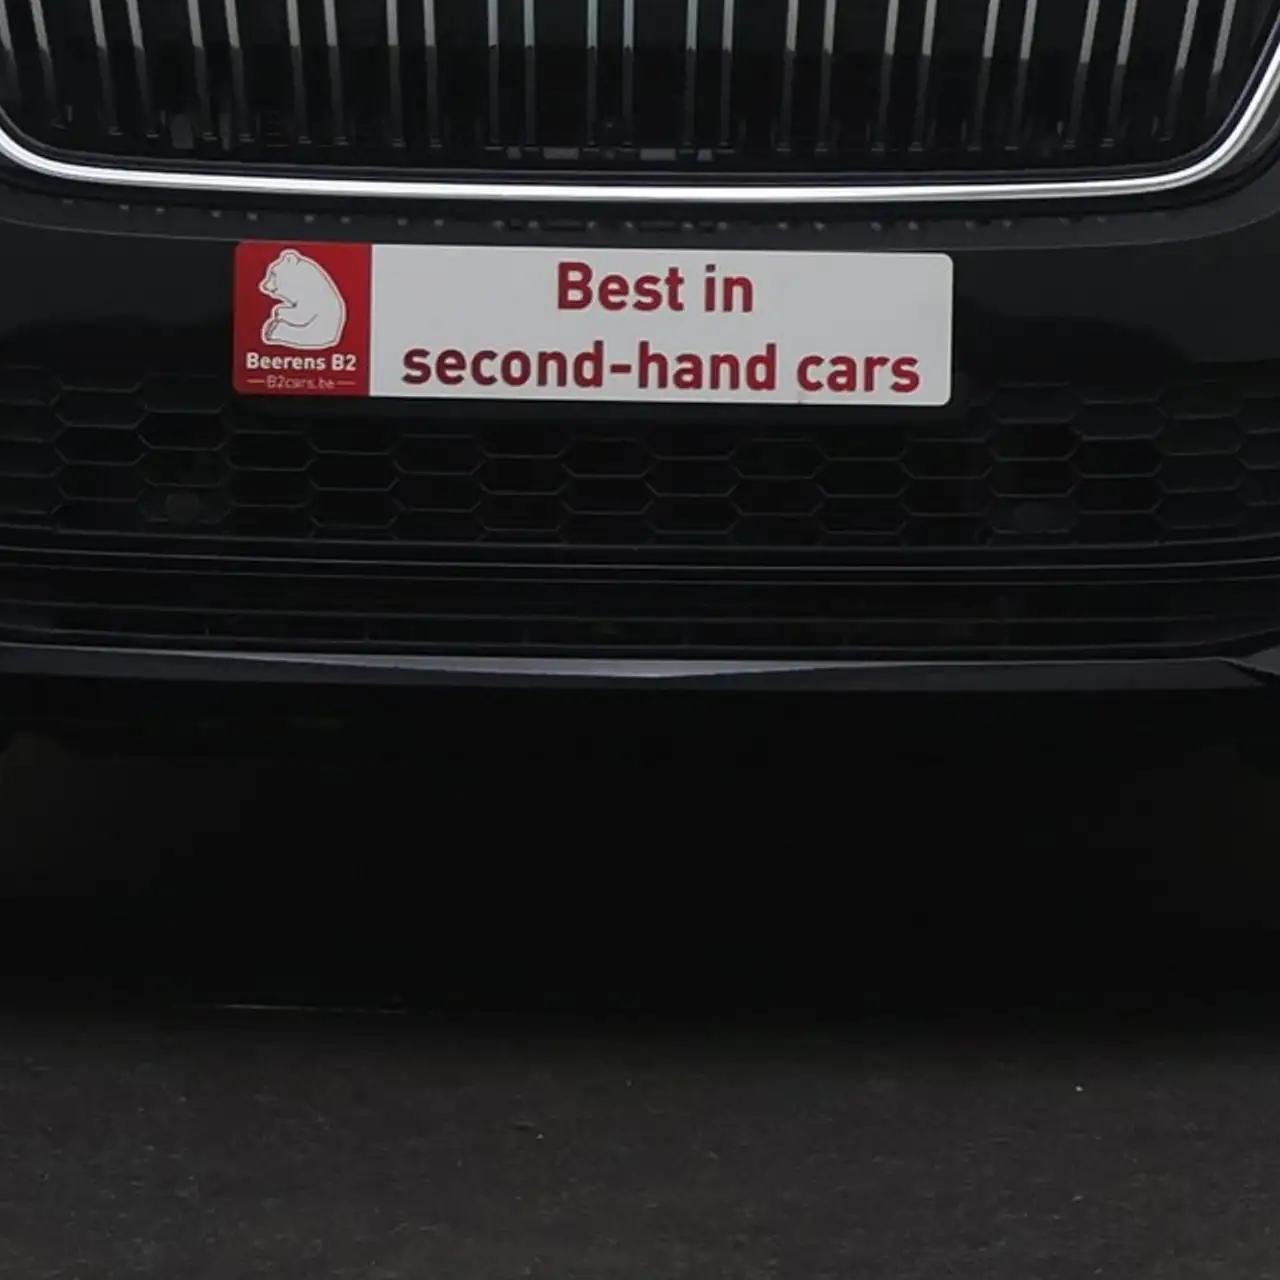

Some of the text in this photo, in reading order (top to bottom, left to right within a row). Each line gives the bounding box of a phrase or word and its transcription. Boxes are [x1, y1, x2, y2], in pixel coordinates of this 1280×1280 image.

[558, 262, 753, 313] Best in
[246, 352, 357, 371] Beerens B2
[401, 340, 920, 393] second-hand cars
